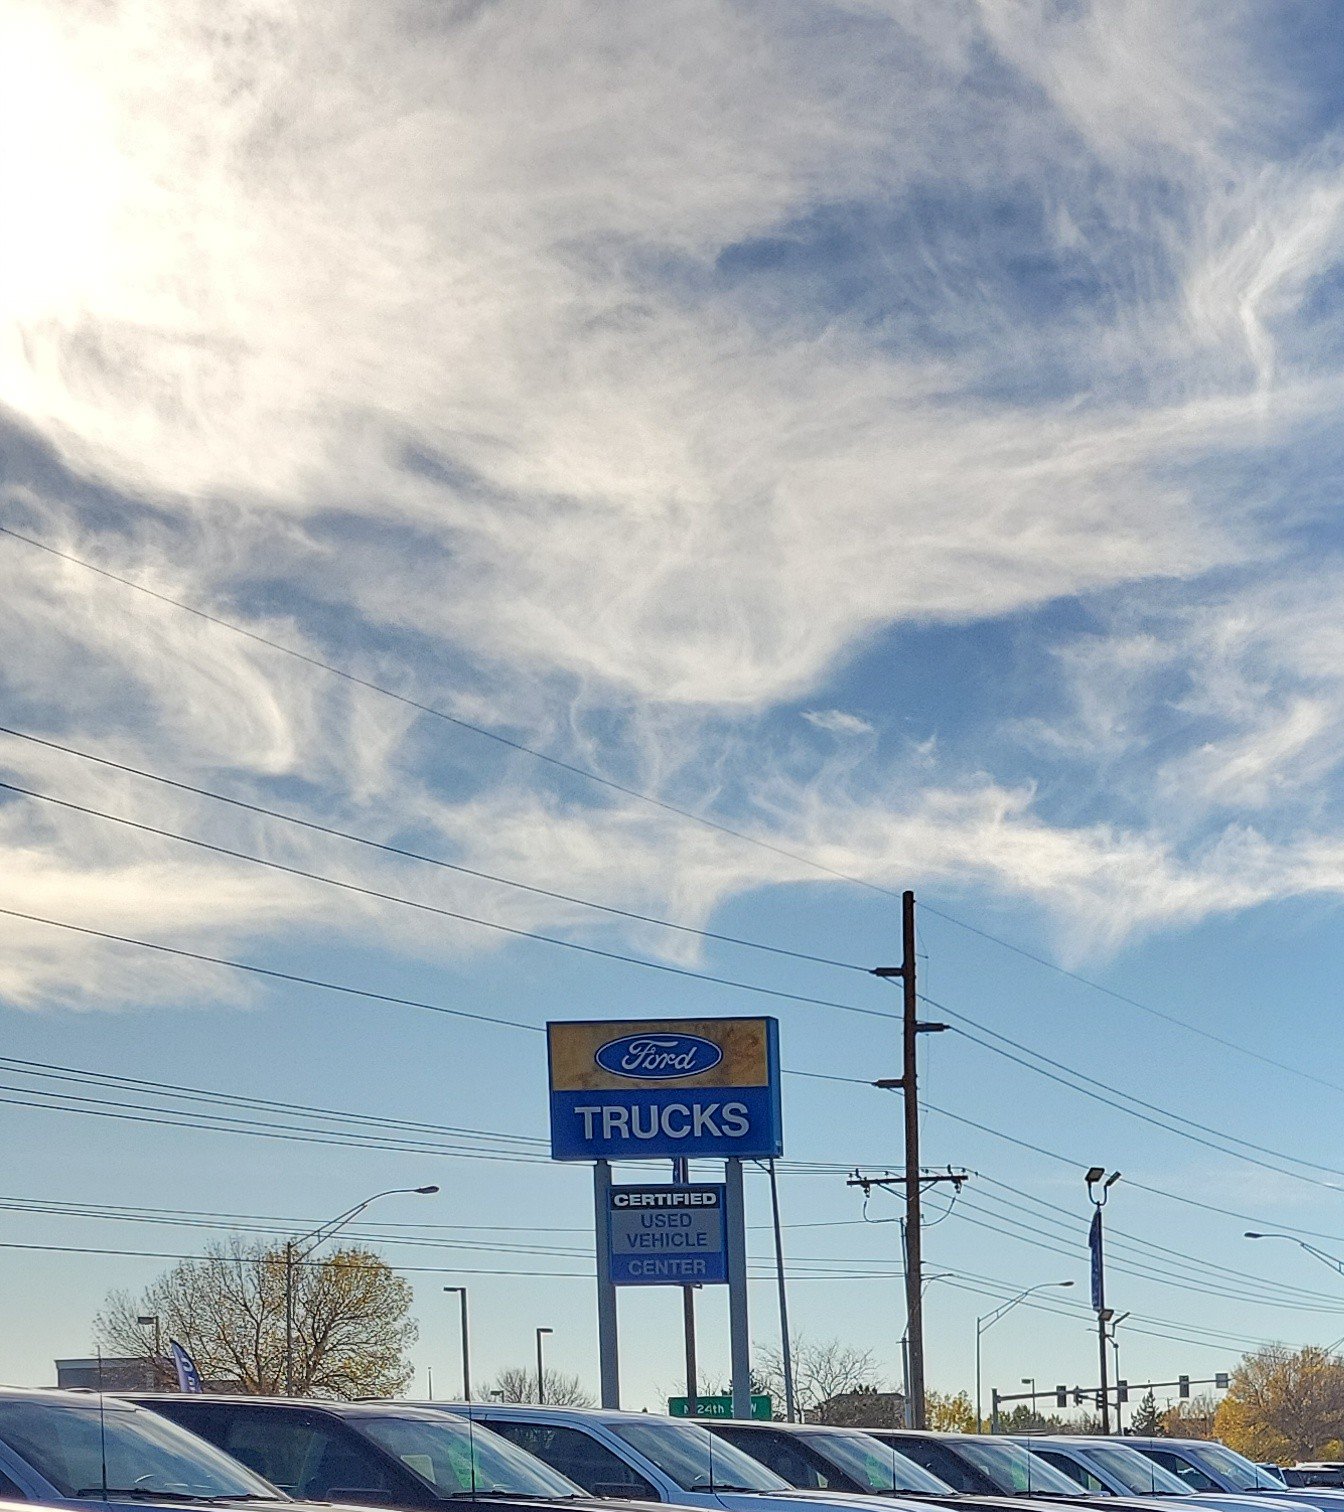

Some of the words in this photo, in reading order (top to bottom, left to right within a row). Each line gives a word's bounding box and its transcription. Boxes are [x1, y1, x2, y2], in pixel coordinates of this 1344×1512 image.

[622, 1040, 698, 1070] Ford
[574, 1102, 750, 1140] TRUCKS
[613, 1192, 717, 1207] CERTIFIED
[641, 1213, 692, 1229] USED
[627, 1231, 707, 1249] VEHICLE
[628, 1259, 707, 1275] CENTER
[697, 1403, 725, 1414] 24th
